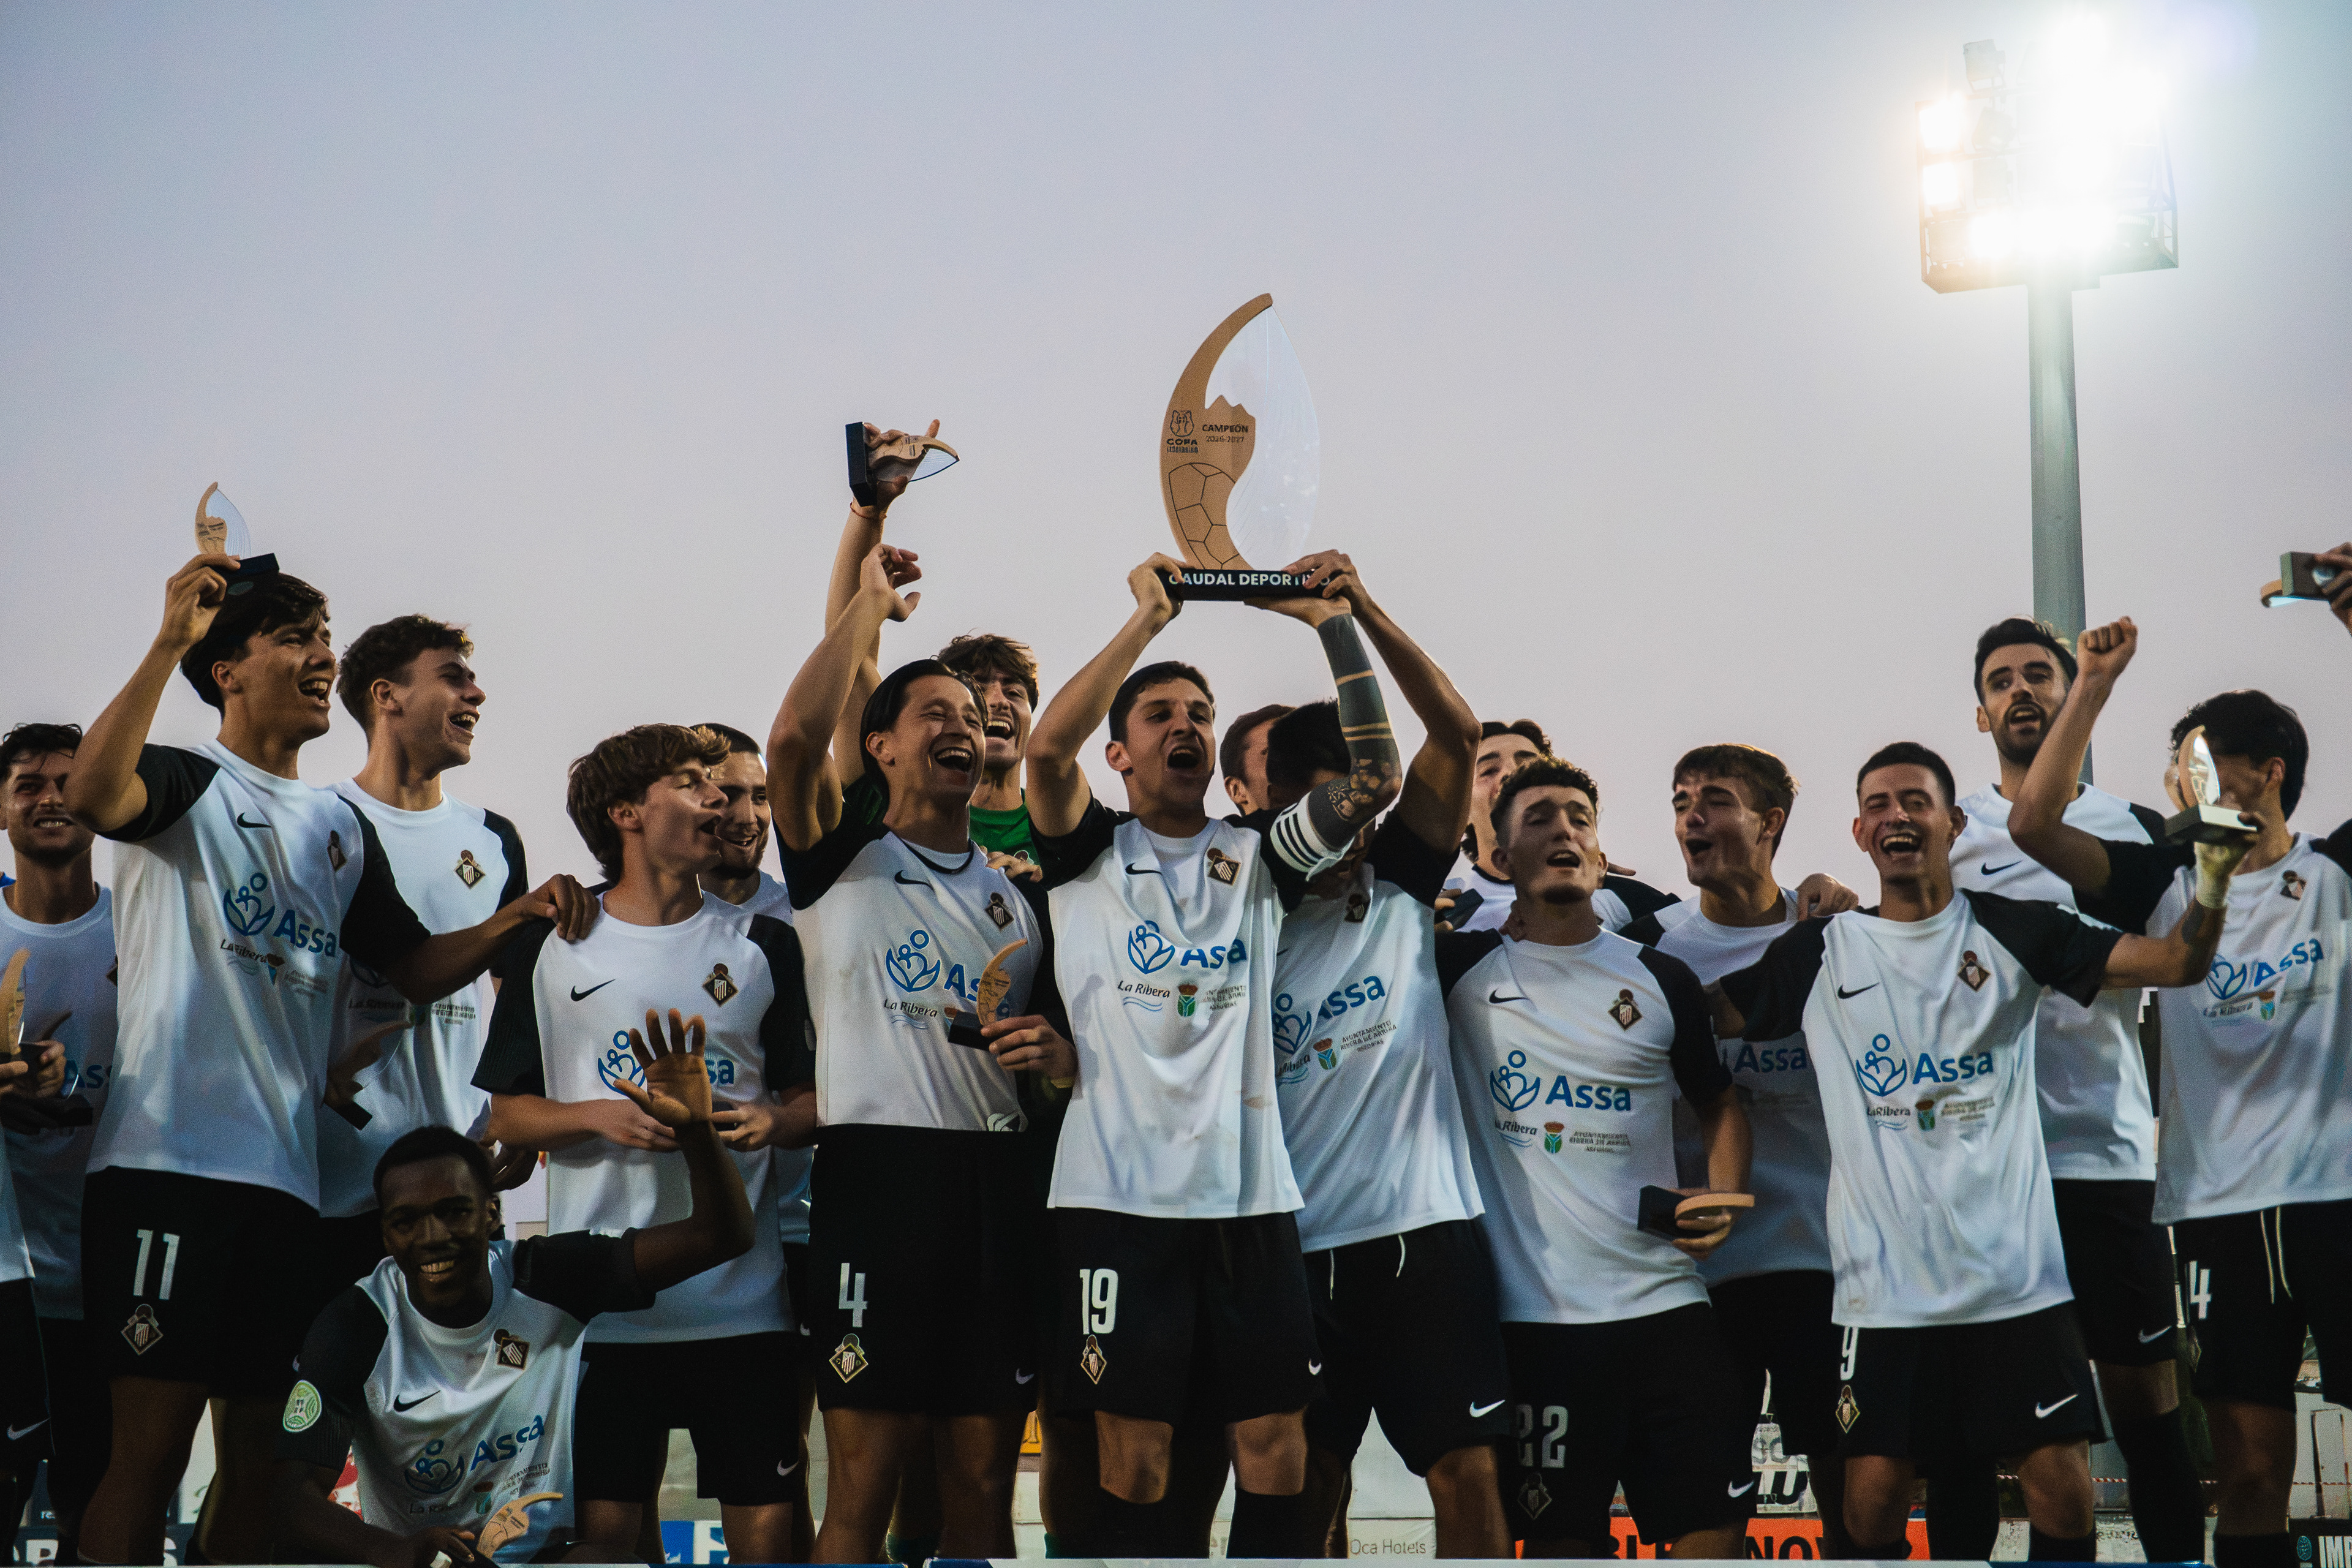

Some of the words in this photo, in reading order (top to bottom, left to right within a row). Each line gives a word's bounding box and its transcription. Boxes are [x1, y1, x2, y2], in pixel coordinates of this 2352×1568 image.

[1169, 573, 1235, 586] CAUDAL
[273, 909, 337, 957] Assa
[1117, 980, 1133, 992] La
[1137, 983, 1170, 998] Ribera
[884, 998, 897, 1012] La
[900, 1001, 938, 1018] Ribera
[1733, 1043, 1807, 1073] Assa
[1912, 1052, 1994, 1085] Assa
[1545, 1075, 1631, 1112] Assa
[1502, 1120, 1537, 1136] Ribera
[133, 1229, 180, 1300] 11
[839, 1262, 869, 1328] 4
[1079, 1267, 1119, 1335] 19
[1839, 1326, 1860, 1381] 9
[1515, 1404, 1569, 1468] 22
[1349, 1539, 1378, 1555] Oca
[1382, 1539, 1427, 1555] Hotels
